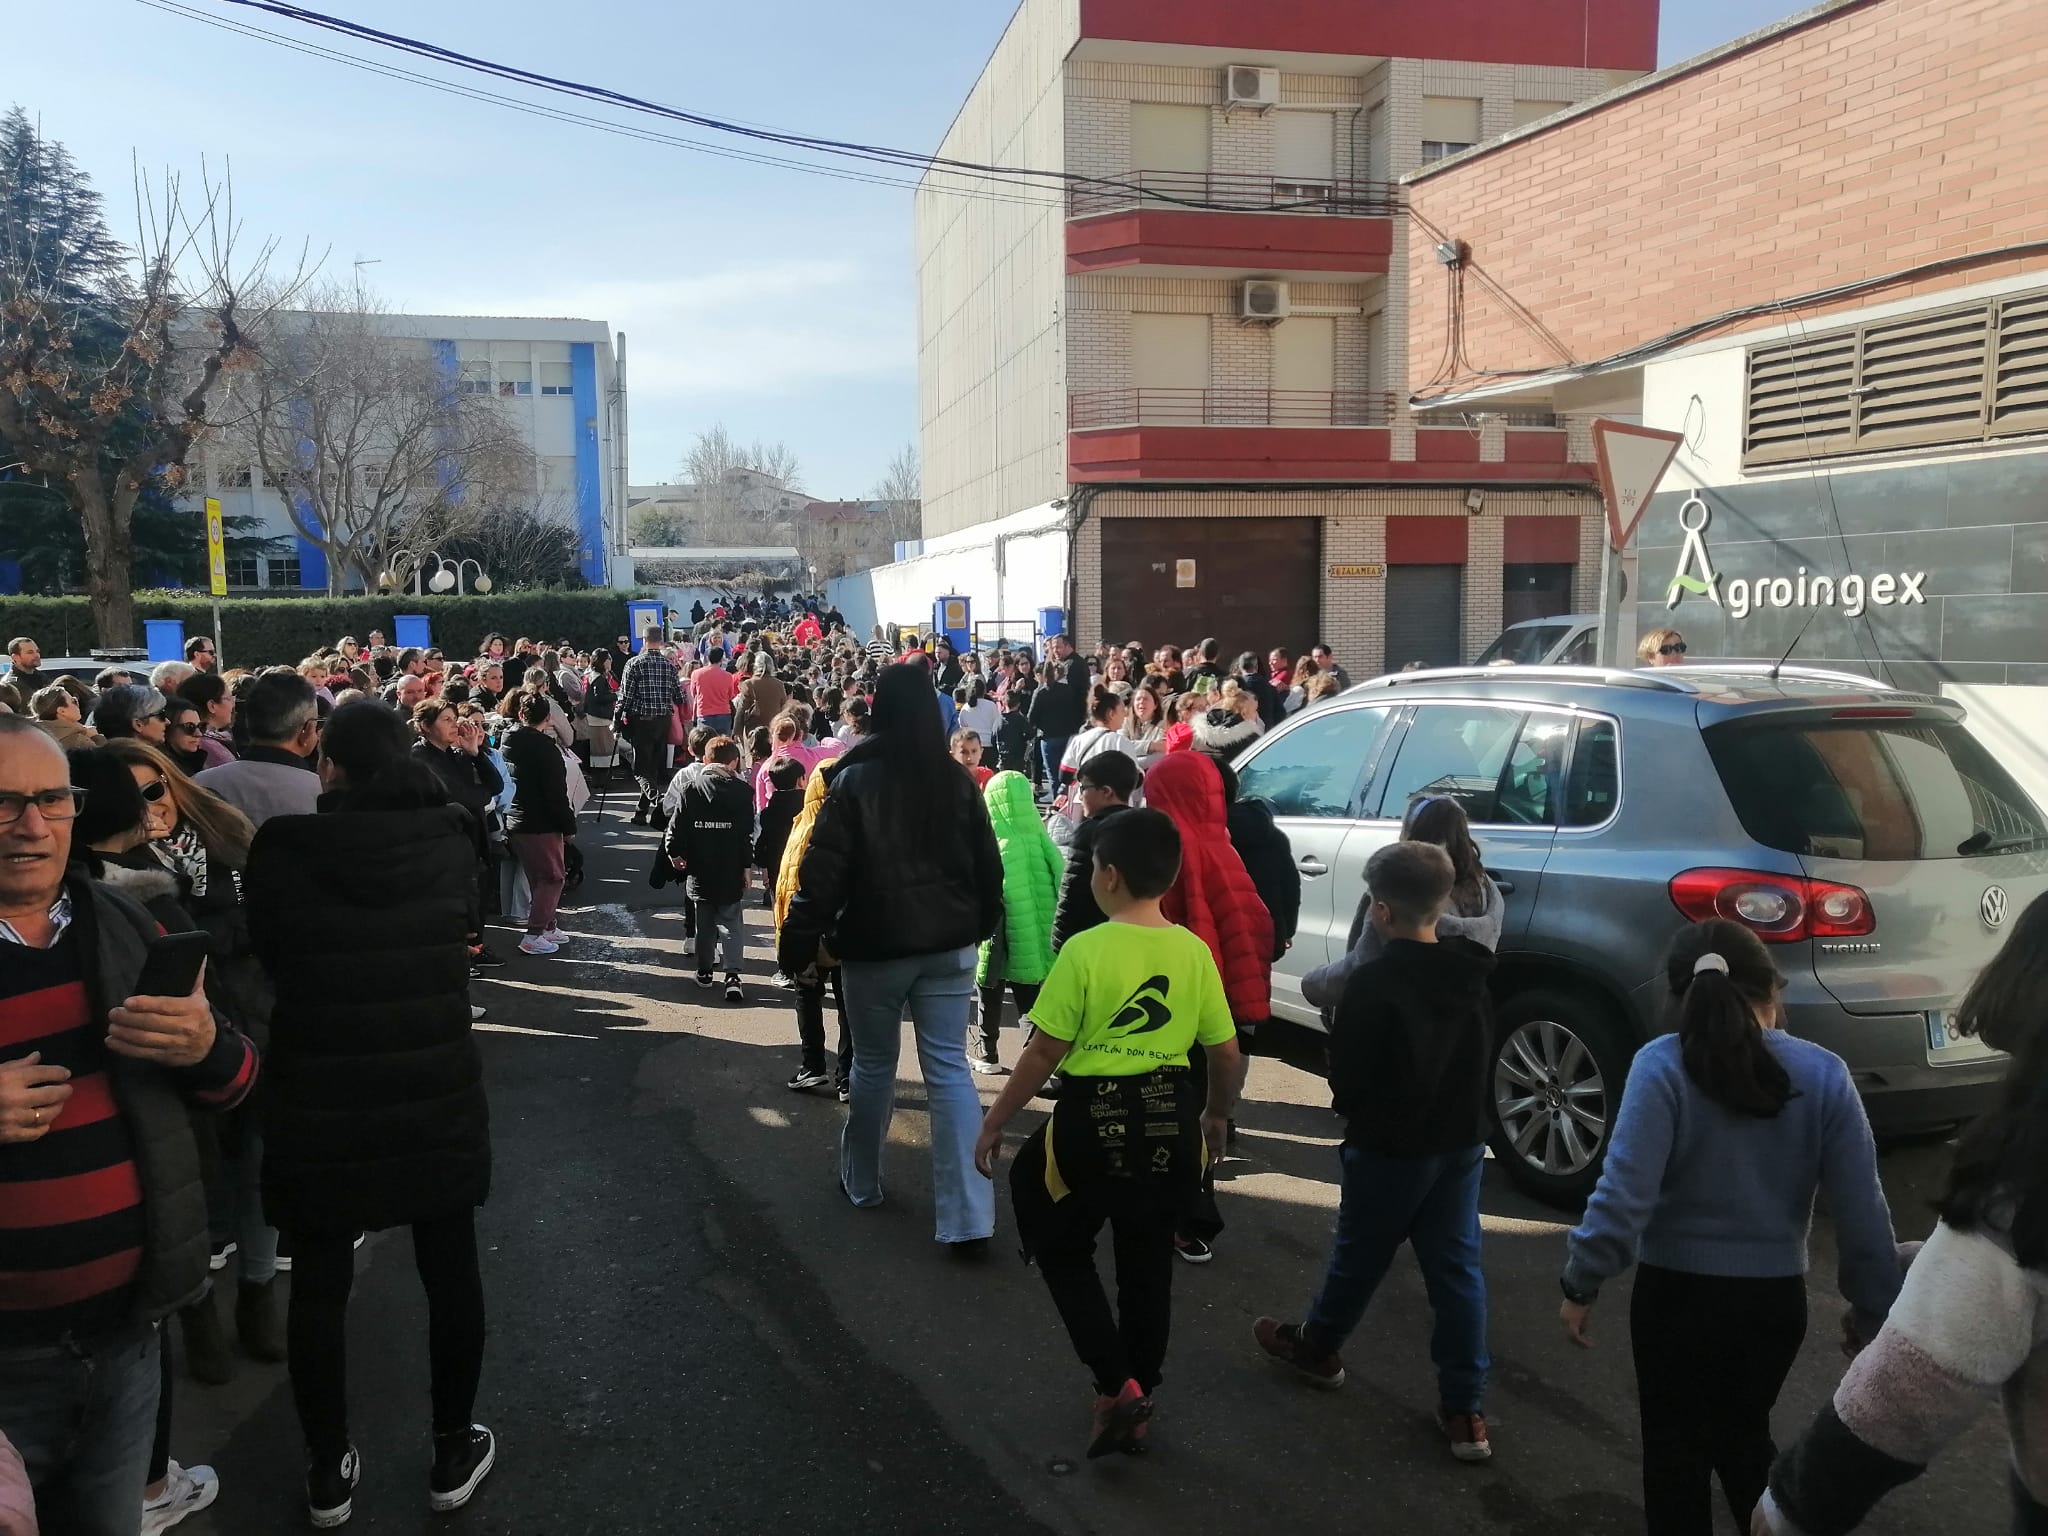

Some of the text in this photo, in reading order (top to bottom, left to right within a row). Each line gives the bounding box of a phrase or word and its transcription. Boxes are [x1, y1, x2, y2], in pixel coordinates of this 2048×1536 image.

[1666, 490, 1927, 619] Agroingex
[1821, 943, 1881, 954] TIGUAN
[1127, 1047, 1145, 1057] DON
